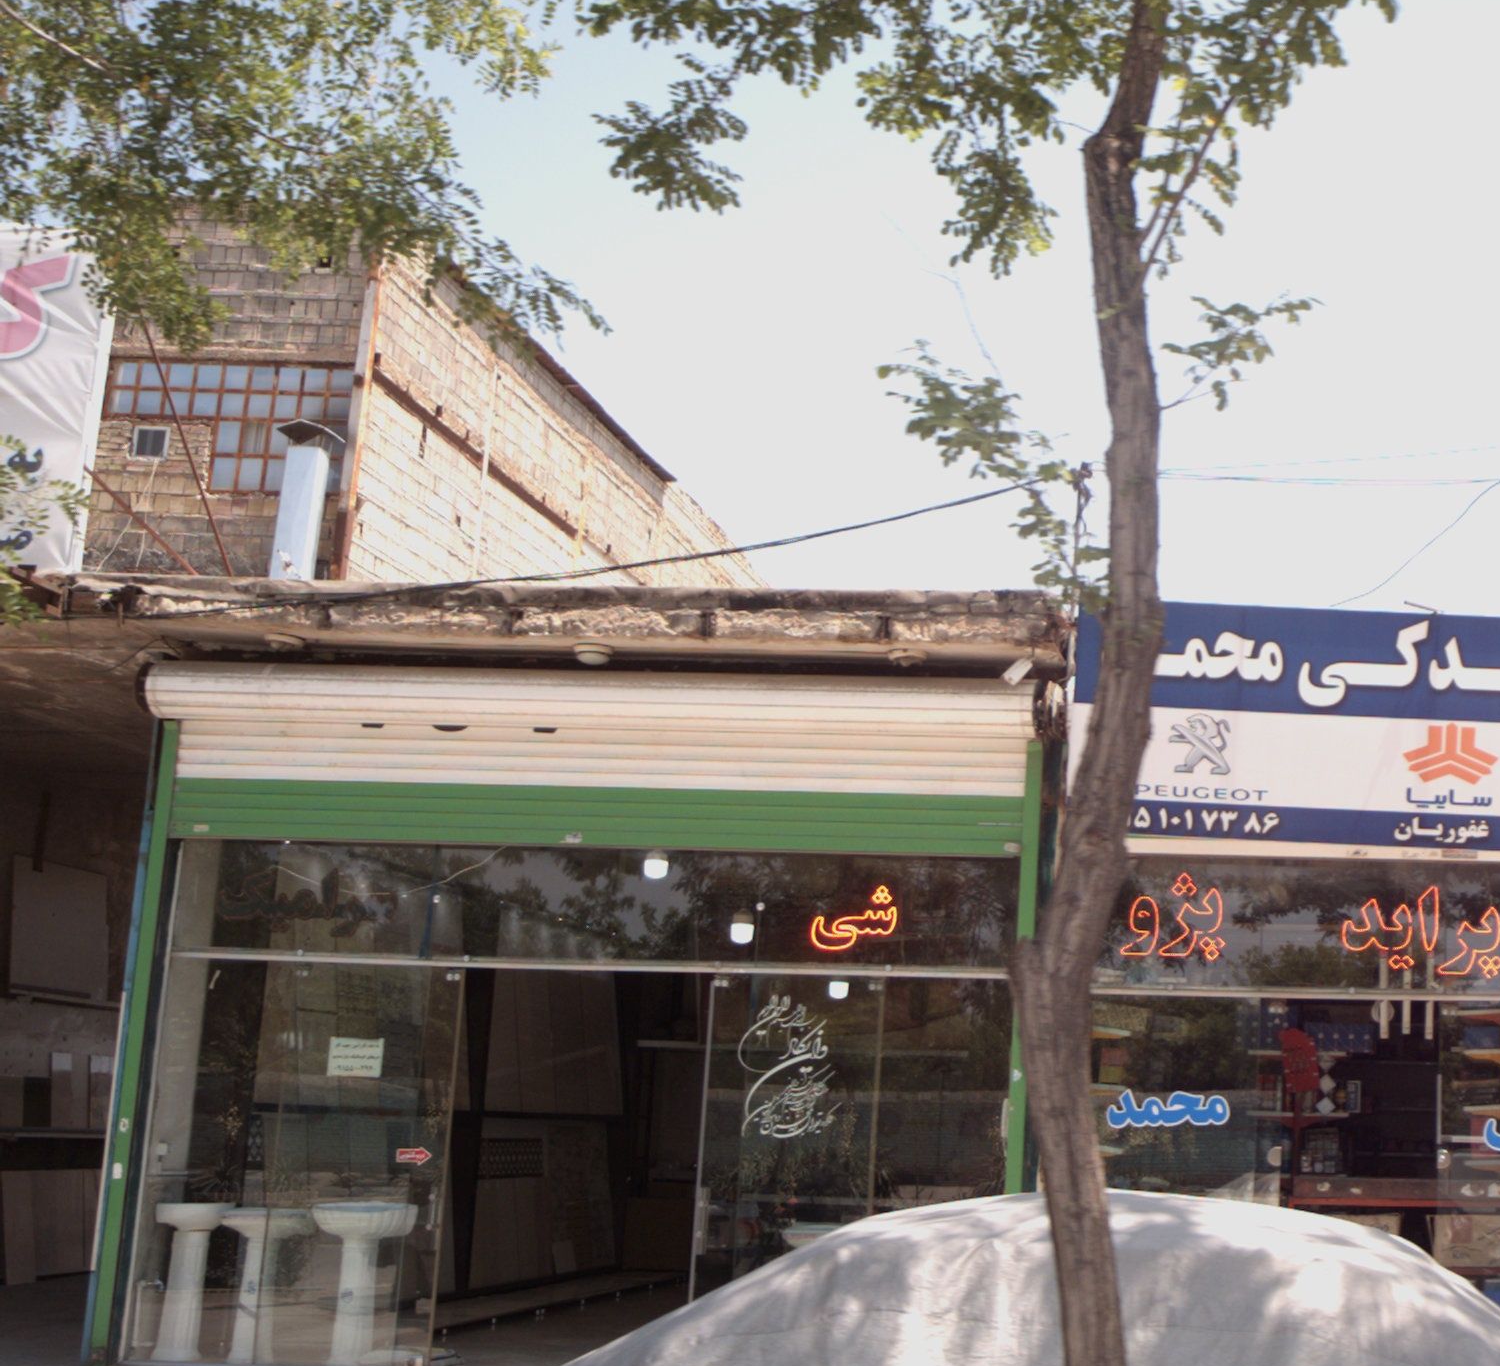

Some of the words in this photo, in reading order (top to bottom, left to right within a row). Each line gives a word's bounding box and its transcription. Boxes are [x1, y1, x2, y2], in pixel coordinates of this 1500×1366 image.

[1152, 631, 1284, 682] محم
[1136, 784, 1270, 803] PEUGEOT
[1404, 787, 1493, 810] سایپا
[1393, 817, 1491, 843] غفوریان
[1119, 871, 1226, 963] پژو
[1106, 1088, 1231, 1129] محمد
